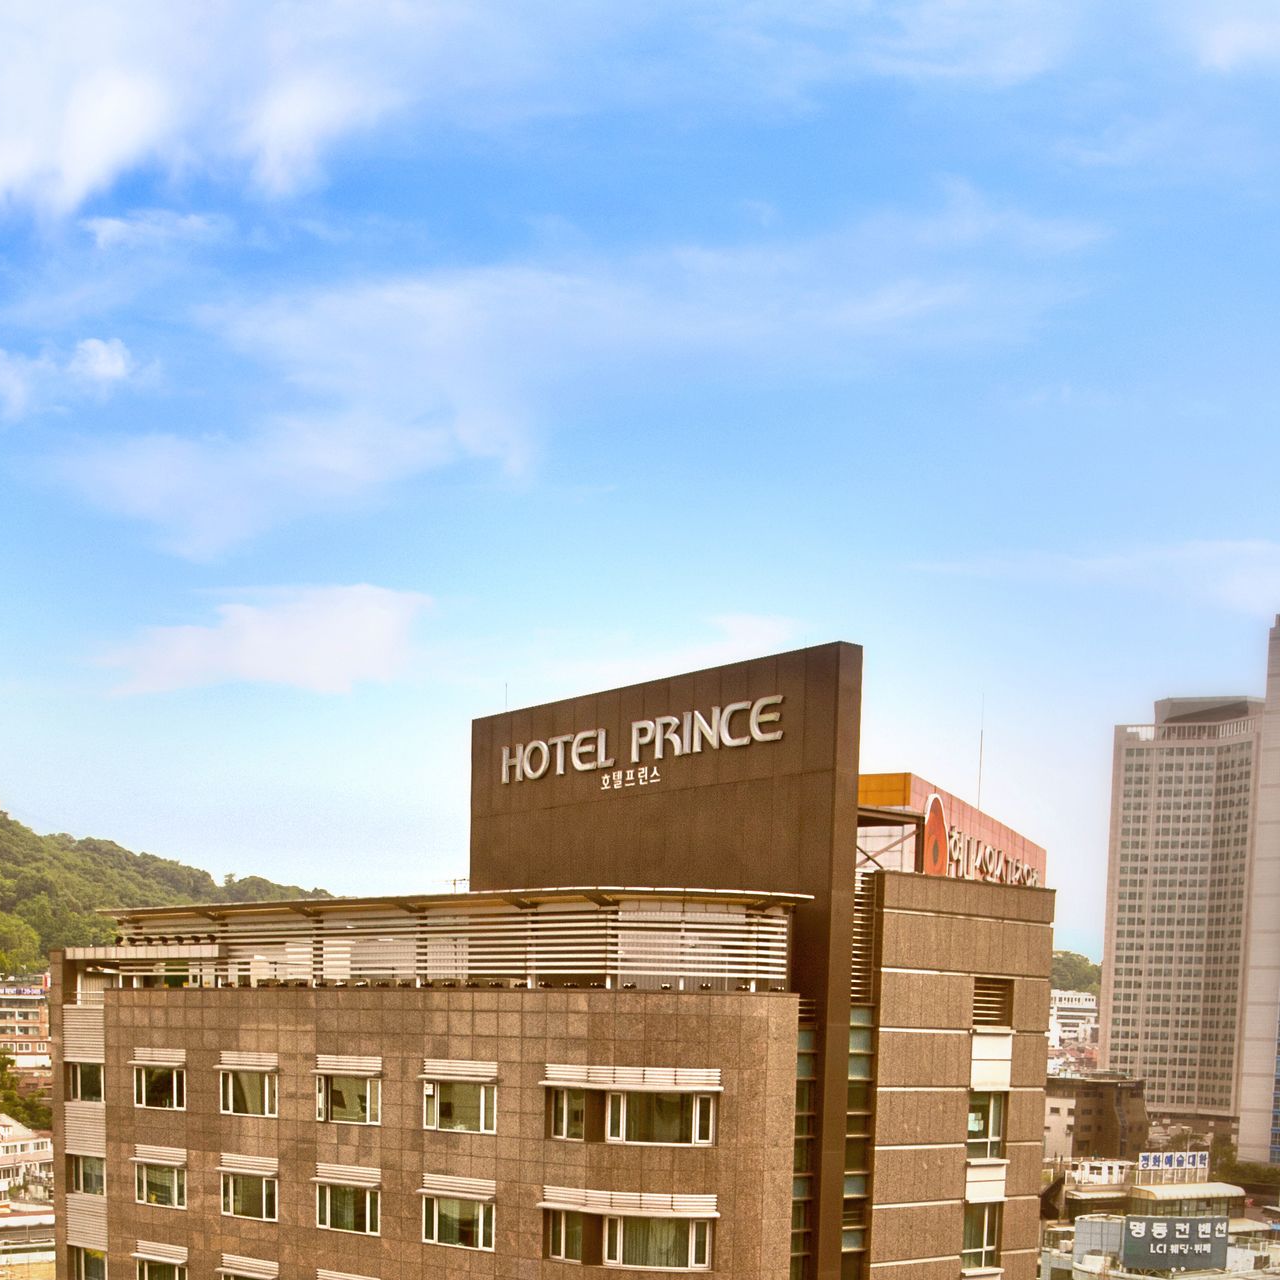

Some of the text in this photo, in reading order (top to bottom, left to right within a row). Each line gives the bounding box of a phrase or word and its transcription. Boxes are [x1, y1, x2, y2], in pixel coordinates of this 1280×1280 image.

[501, 694, 785, 785] HOTEL PRINCE
[600, 766, 662, 791] 호텔프린스
